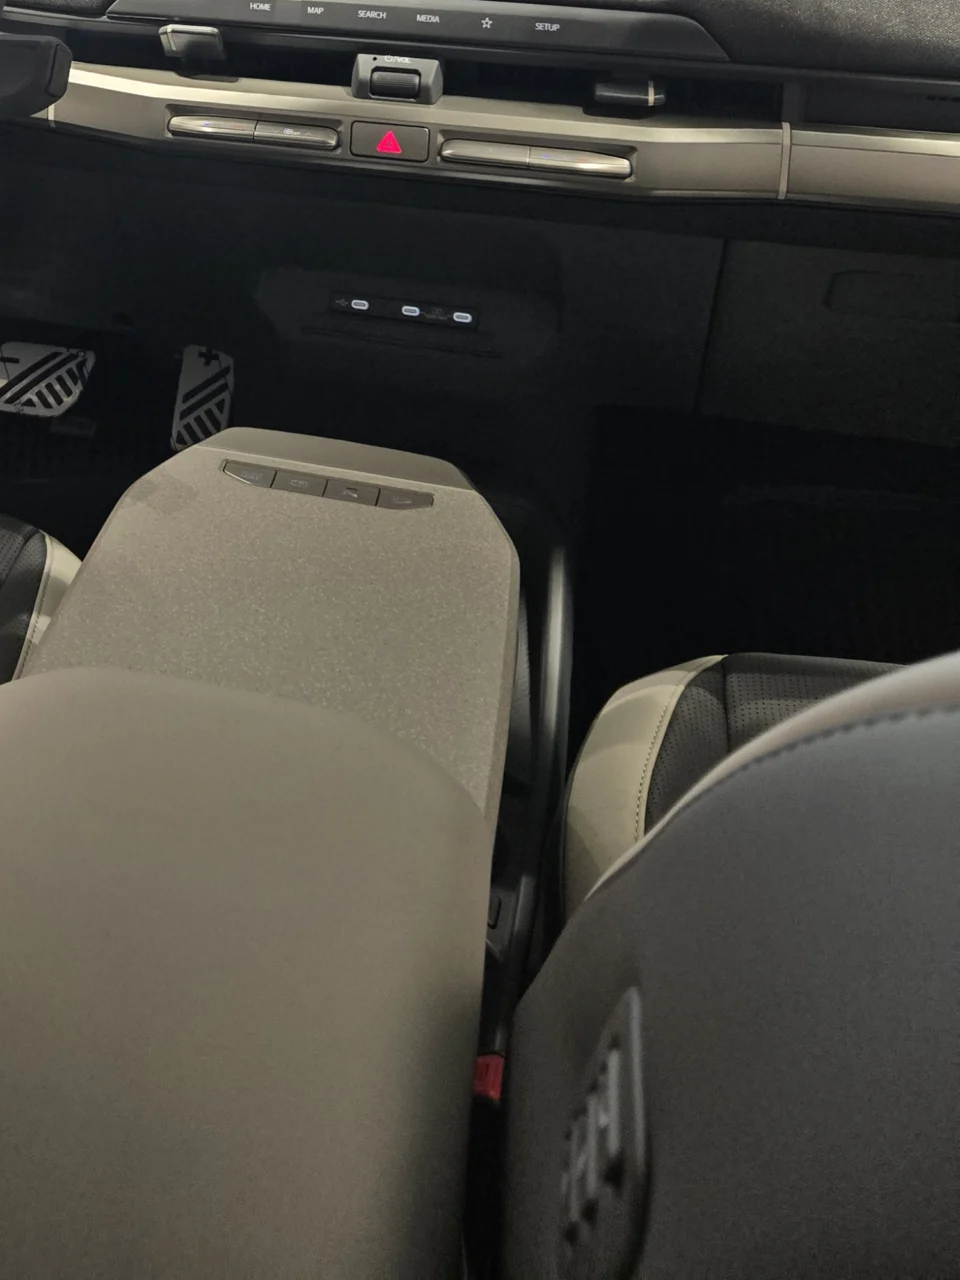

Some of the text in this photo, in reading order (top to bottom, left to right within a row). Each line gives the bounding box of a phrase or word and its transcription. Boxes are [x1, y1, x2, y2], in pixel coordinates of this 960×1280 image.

[249, 2, 272, 11] HOME
[307, 6, 324, 14] MAP
[357, 10, 387, 19] SEARCH
[416, 14, 440, 23] MEDIA
[534, 22, 561, 32] SETUP
